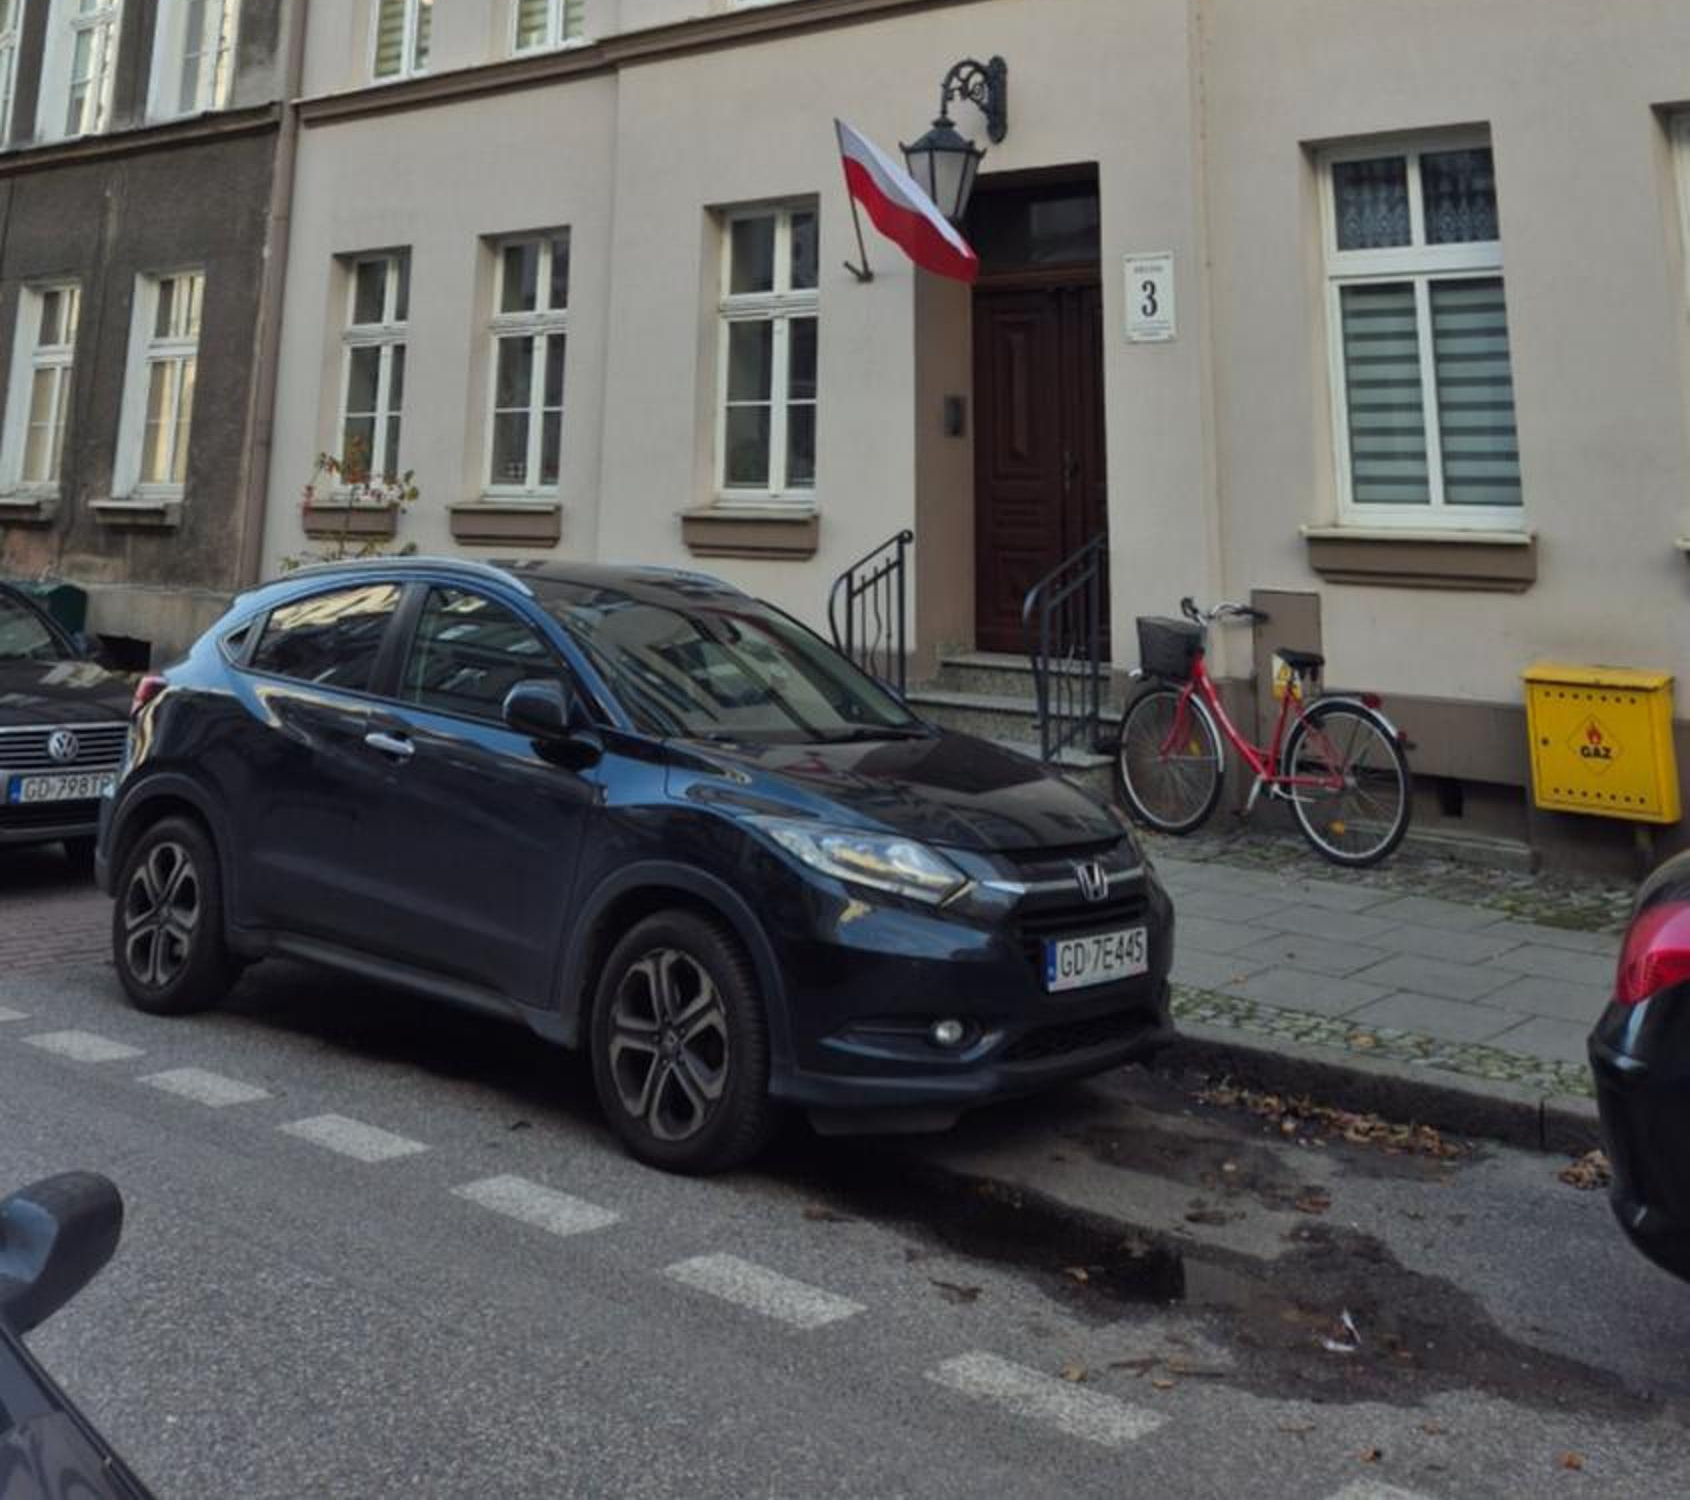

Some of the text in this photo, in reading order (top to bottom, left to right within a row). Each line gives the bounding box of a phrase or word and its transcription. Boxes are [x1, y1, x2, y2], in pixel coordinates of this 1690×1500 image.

[1141, 279, 1158, 317] 3
[1580, 744, 1613, 759] GAZ
[25, 778, 49, 799] GD
[1061, 942, 1086, 977] GD
